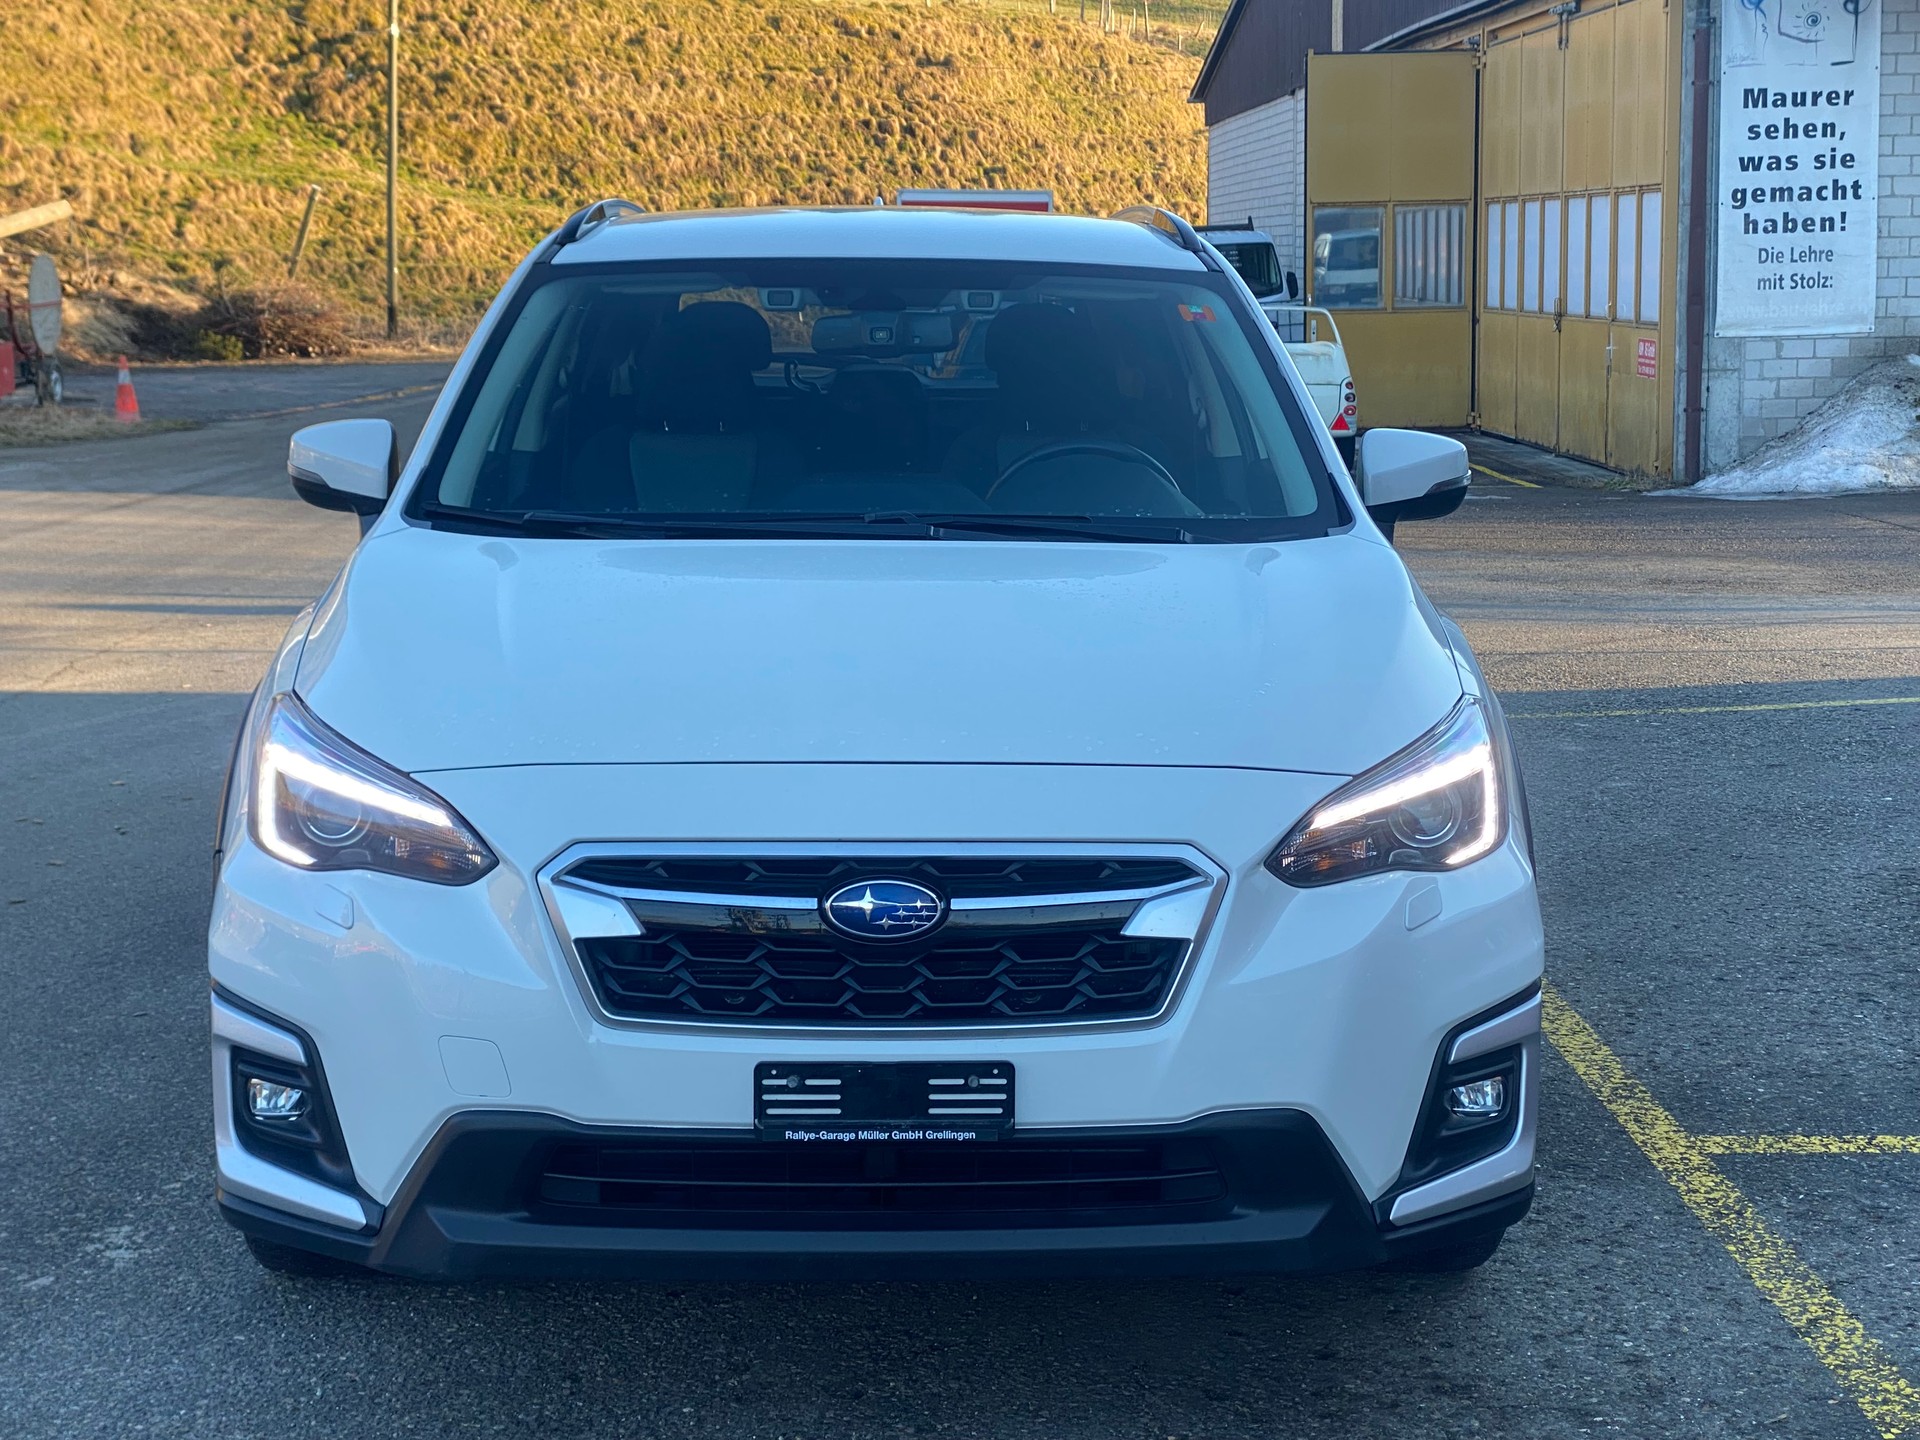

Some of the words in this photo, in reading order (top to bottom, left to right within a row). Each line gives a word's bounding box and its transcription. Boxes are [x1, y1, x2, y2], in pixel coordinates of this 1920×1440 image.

[1743, 87, 1855, 109] Maurer
[1747, 117, 1846, 141] sehen,
[1738, 155, 1799, 172] was
[1813, 147, 1856, 170] sie
[1731, 179, 1863, 210] gemacht
[1743, 211, 1847, 235] haben!
[1758, 247, 1784, 264] Die
[1790, 245, 1834, 263] Lehre
[1757, 273, 1784, 291] mit
[1790, 271, 1834, 290] Stolz:
[785, 1130, 856, 1142] Rallye-Garage
[858, 1130, 890, 1140] Müller
[891, 1130, 923, 1140] GmbH
[925, 1130, 976, 1141] Grellingen
